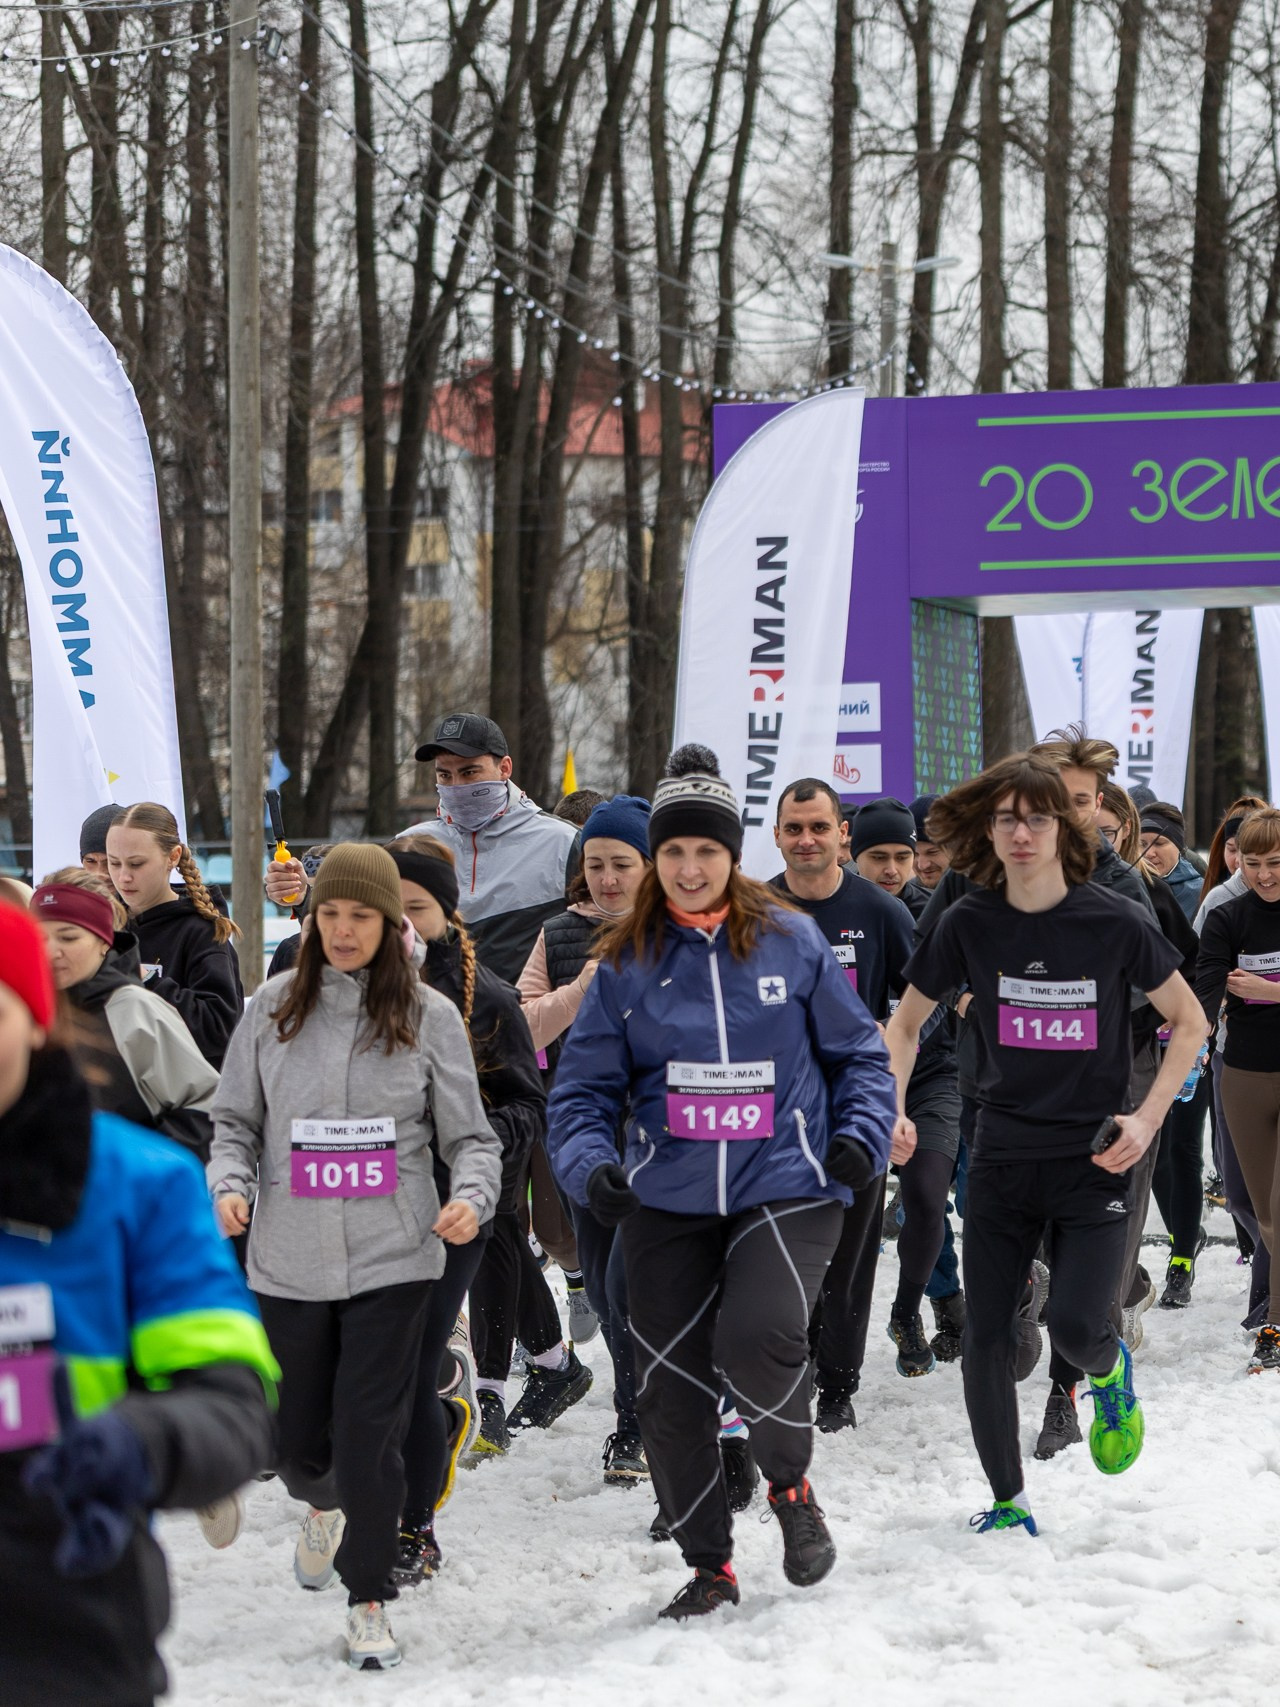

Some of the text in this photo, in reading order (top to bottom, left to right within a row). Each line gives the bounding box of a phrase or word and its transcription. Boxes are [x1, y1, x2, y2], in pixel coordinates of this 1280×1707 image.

[979, 463, 1094, 532] 20
[840, 929, 865, 939] FILA
[1011, 1016, 1085, 1042] 1144
[682, 1104, 762, 1130] 1149
[304, 1161, 384, 1188] 1015
